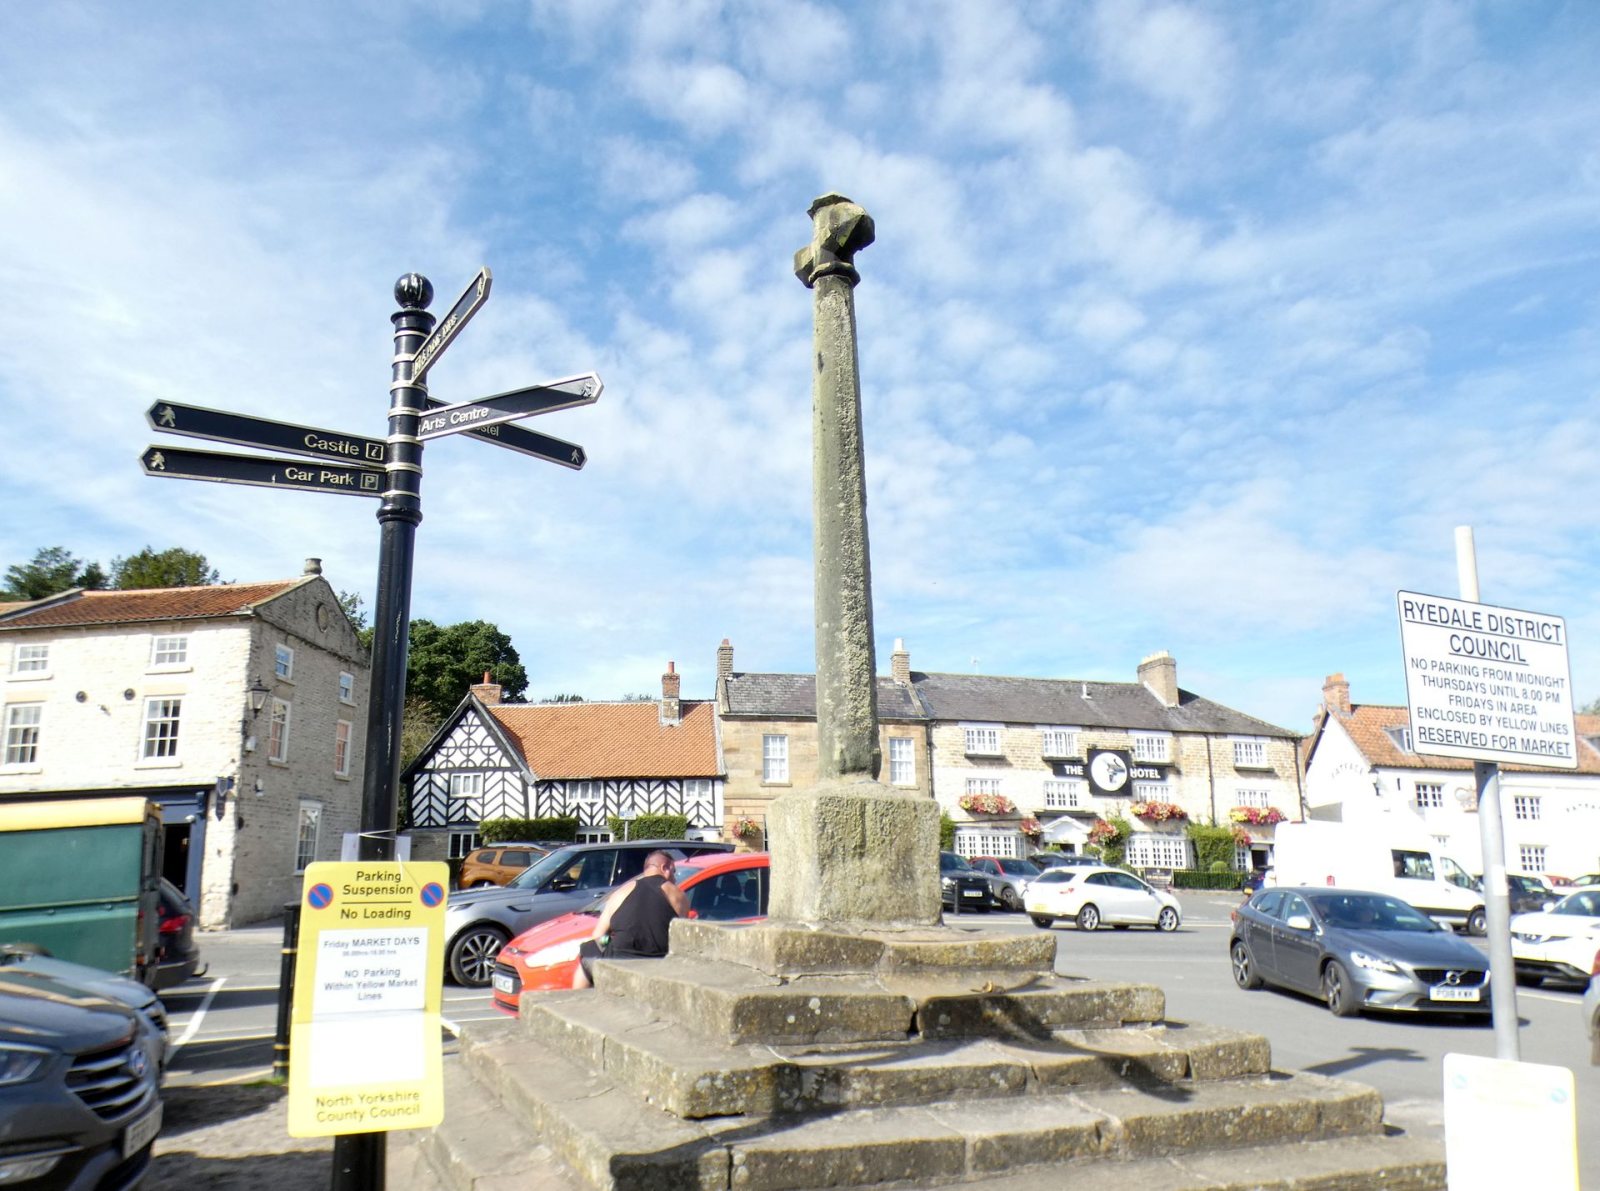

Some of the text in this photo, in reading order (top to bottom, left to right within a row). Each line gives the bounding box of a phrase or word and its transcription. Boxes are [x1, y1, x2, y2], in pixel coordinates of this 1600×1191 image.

[420, 407, 489, 433] Arts Centre
[304, 434, 360, 456] Castle
[285, 467, 315, 482] Car
[320, 470, 354, 486] Park
[1403, 600, 1561, 643] RYEDALE DISTRICT
[1449, 634, 1527, 662] COUNCIL
[1411, 657, 1566, 688] NO PARKING FROM MIDNIGHT
[1421, 675, 1560, 704] THURSDAYS UNTIL 8.00 PM
[1448, 694, 1537, 716] FRIDAYS IN AREA
[1417, 706, 1569, 736] ENCLOSED BY YELLOW LINES
[1418, 726, 1570, 756] RESERVED FOR MARKET
[1064, 765, 1084, 775] THE
[356, 871, 402, 883] Parking
[342, 884, 414, 897] Suspension
[340, 908, 412, 920] No Loading
[323, 936, 420, 950] Friday MARKET DAYS
[344, 968, 401, 978] NO Parking
[324, 978, 419, 991] Within Yellow Market
[357, 992, 383, 1001] Lines
[316, 1091, 420, 1108] North Yorkshire
[316, 1104, 420, 1123] County Council
